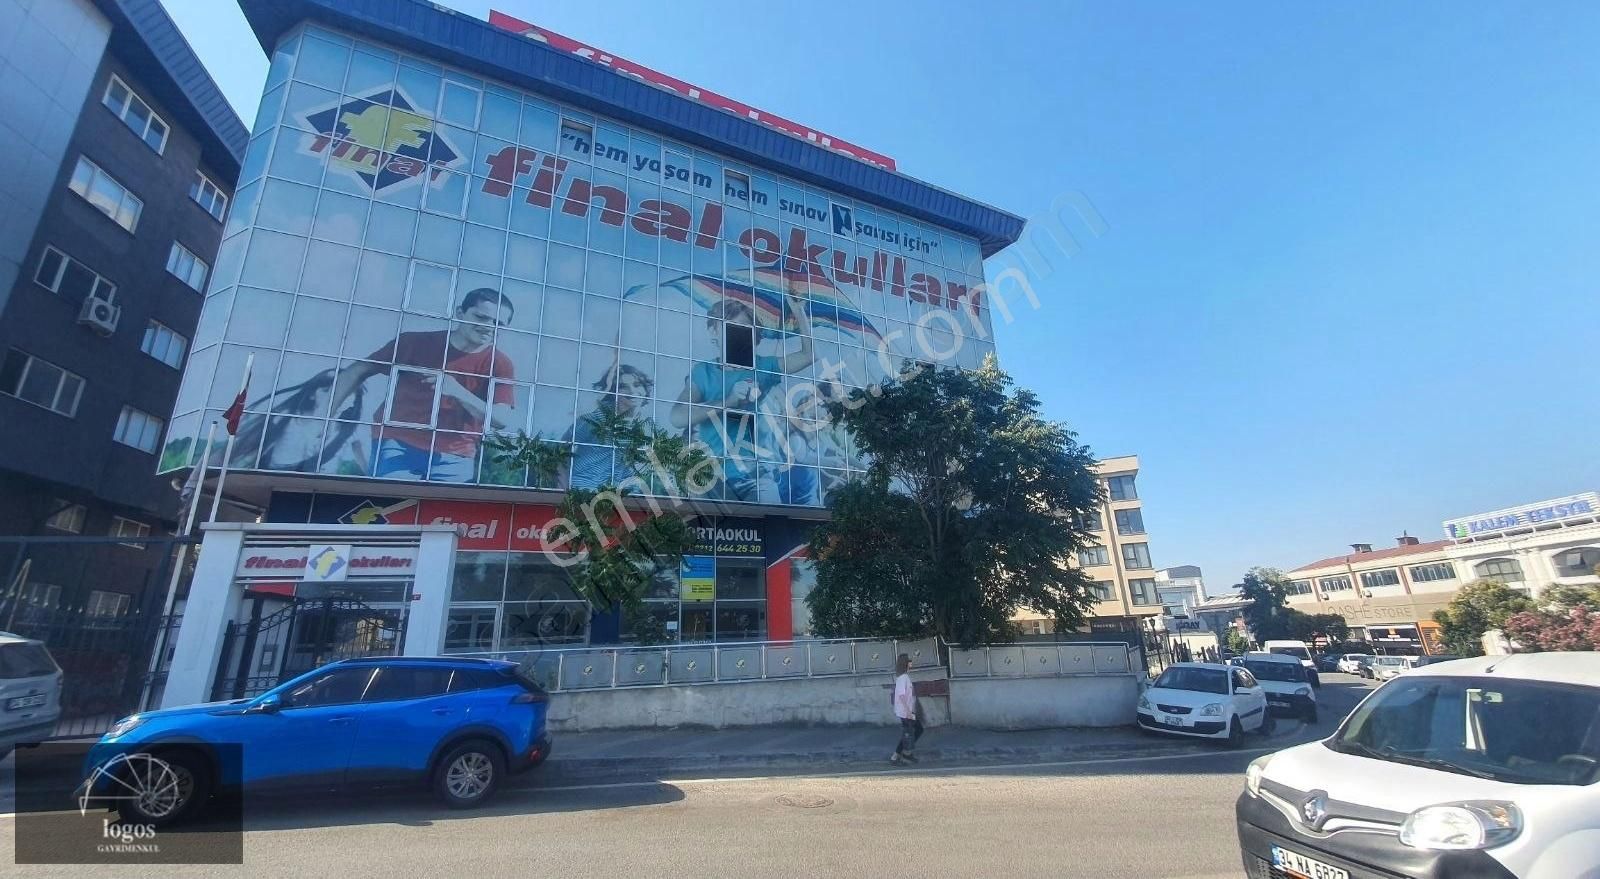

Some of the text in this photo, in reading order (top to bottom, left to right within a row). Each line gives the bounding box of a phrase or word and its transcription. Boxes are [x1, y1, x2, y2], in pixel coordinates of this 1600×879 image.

[634, 154, 712, 189] yaşam
[724, 182, 768, 206] hem
[779, 198, 827, 222] sınav
[481, 146, 981, 317] final okulları
[717, 544, 734, 552] 644
[736, 545, 749, 553] 25
[750, 545, 761, 553] 30
[244, 556, 308, 569] final
[1374, 607, 1412, 619] STORE
[1279, 850, 1293, 868] 34
